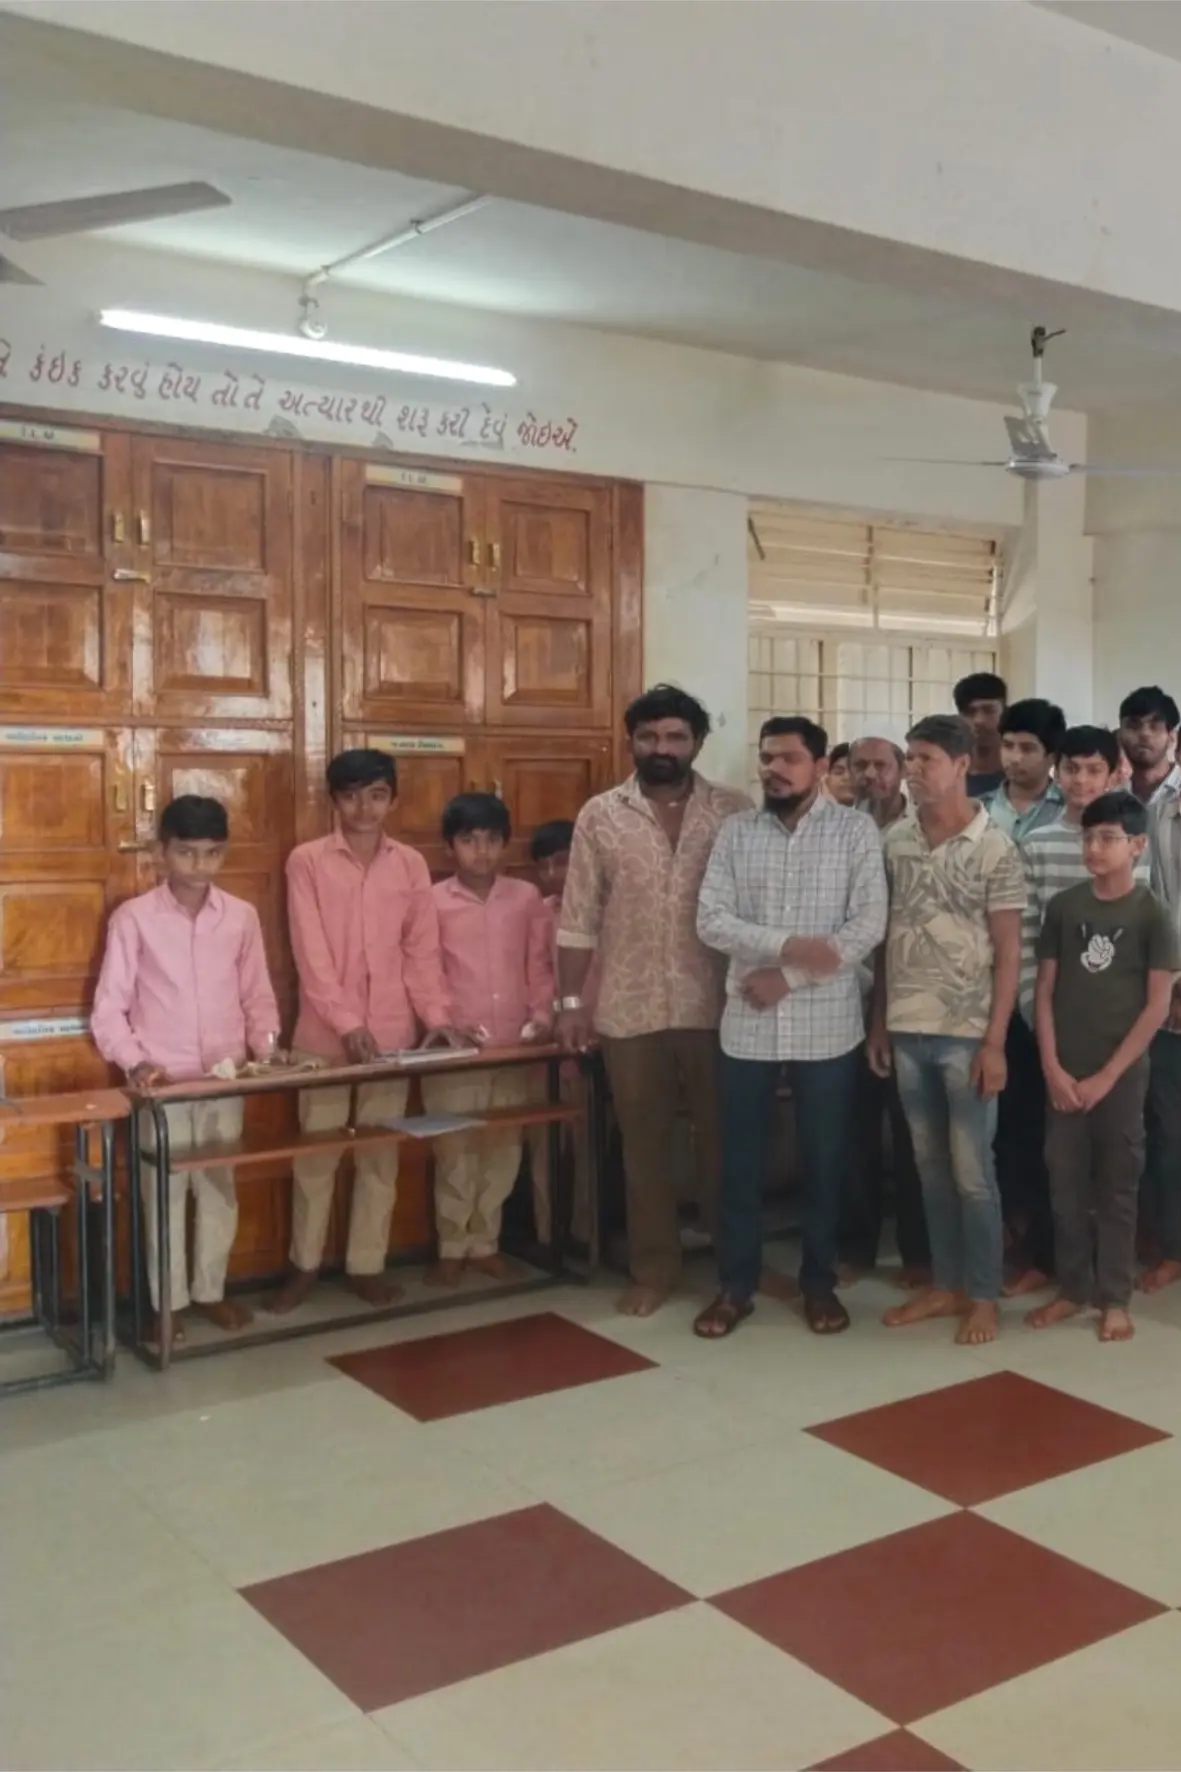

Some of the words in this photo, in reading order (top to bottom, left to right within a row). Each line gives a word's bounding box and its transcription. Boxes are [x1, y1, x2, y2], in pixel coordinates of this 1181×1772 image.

[97, 361, 150, 400] કરવું
[159, 361, 202, 403] હોય
[278, 390, 388, 427] અત્યારથી
[436, 407, 470, 438] કરી
